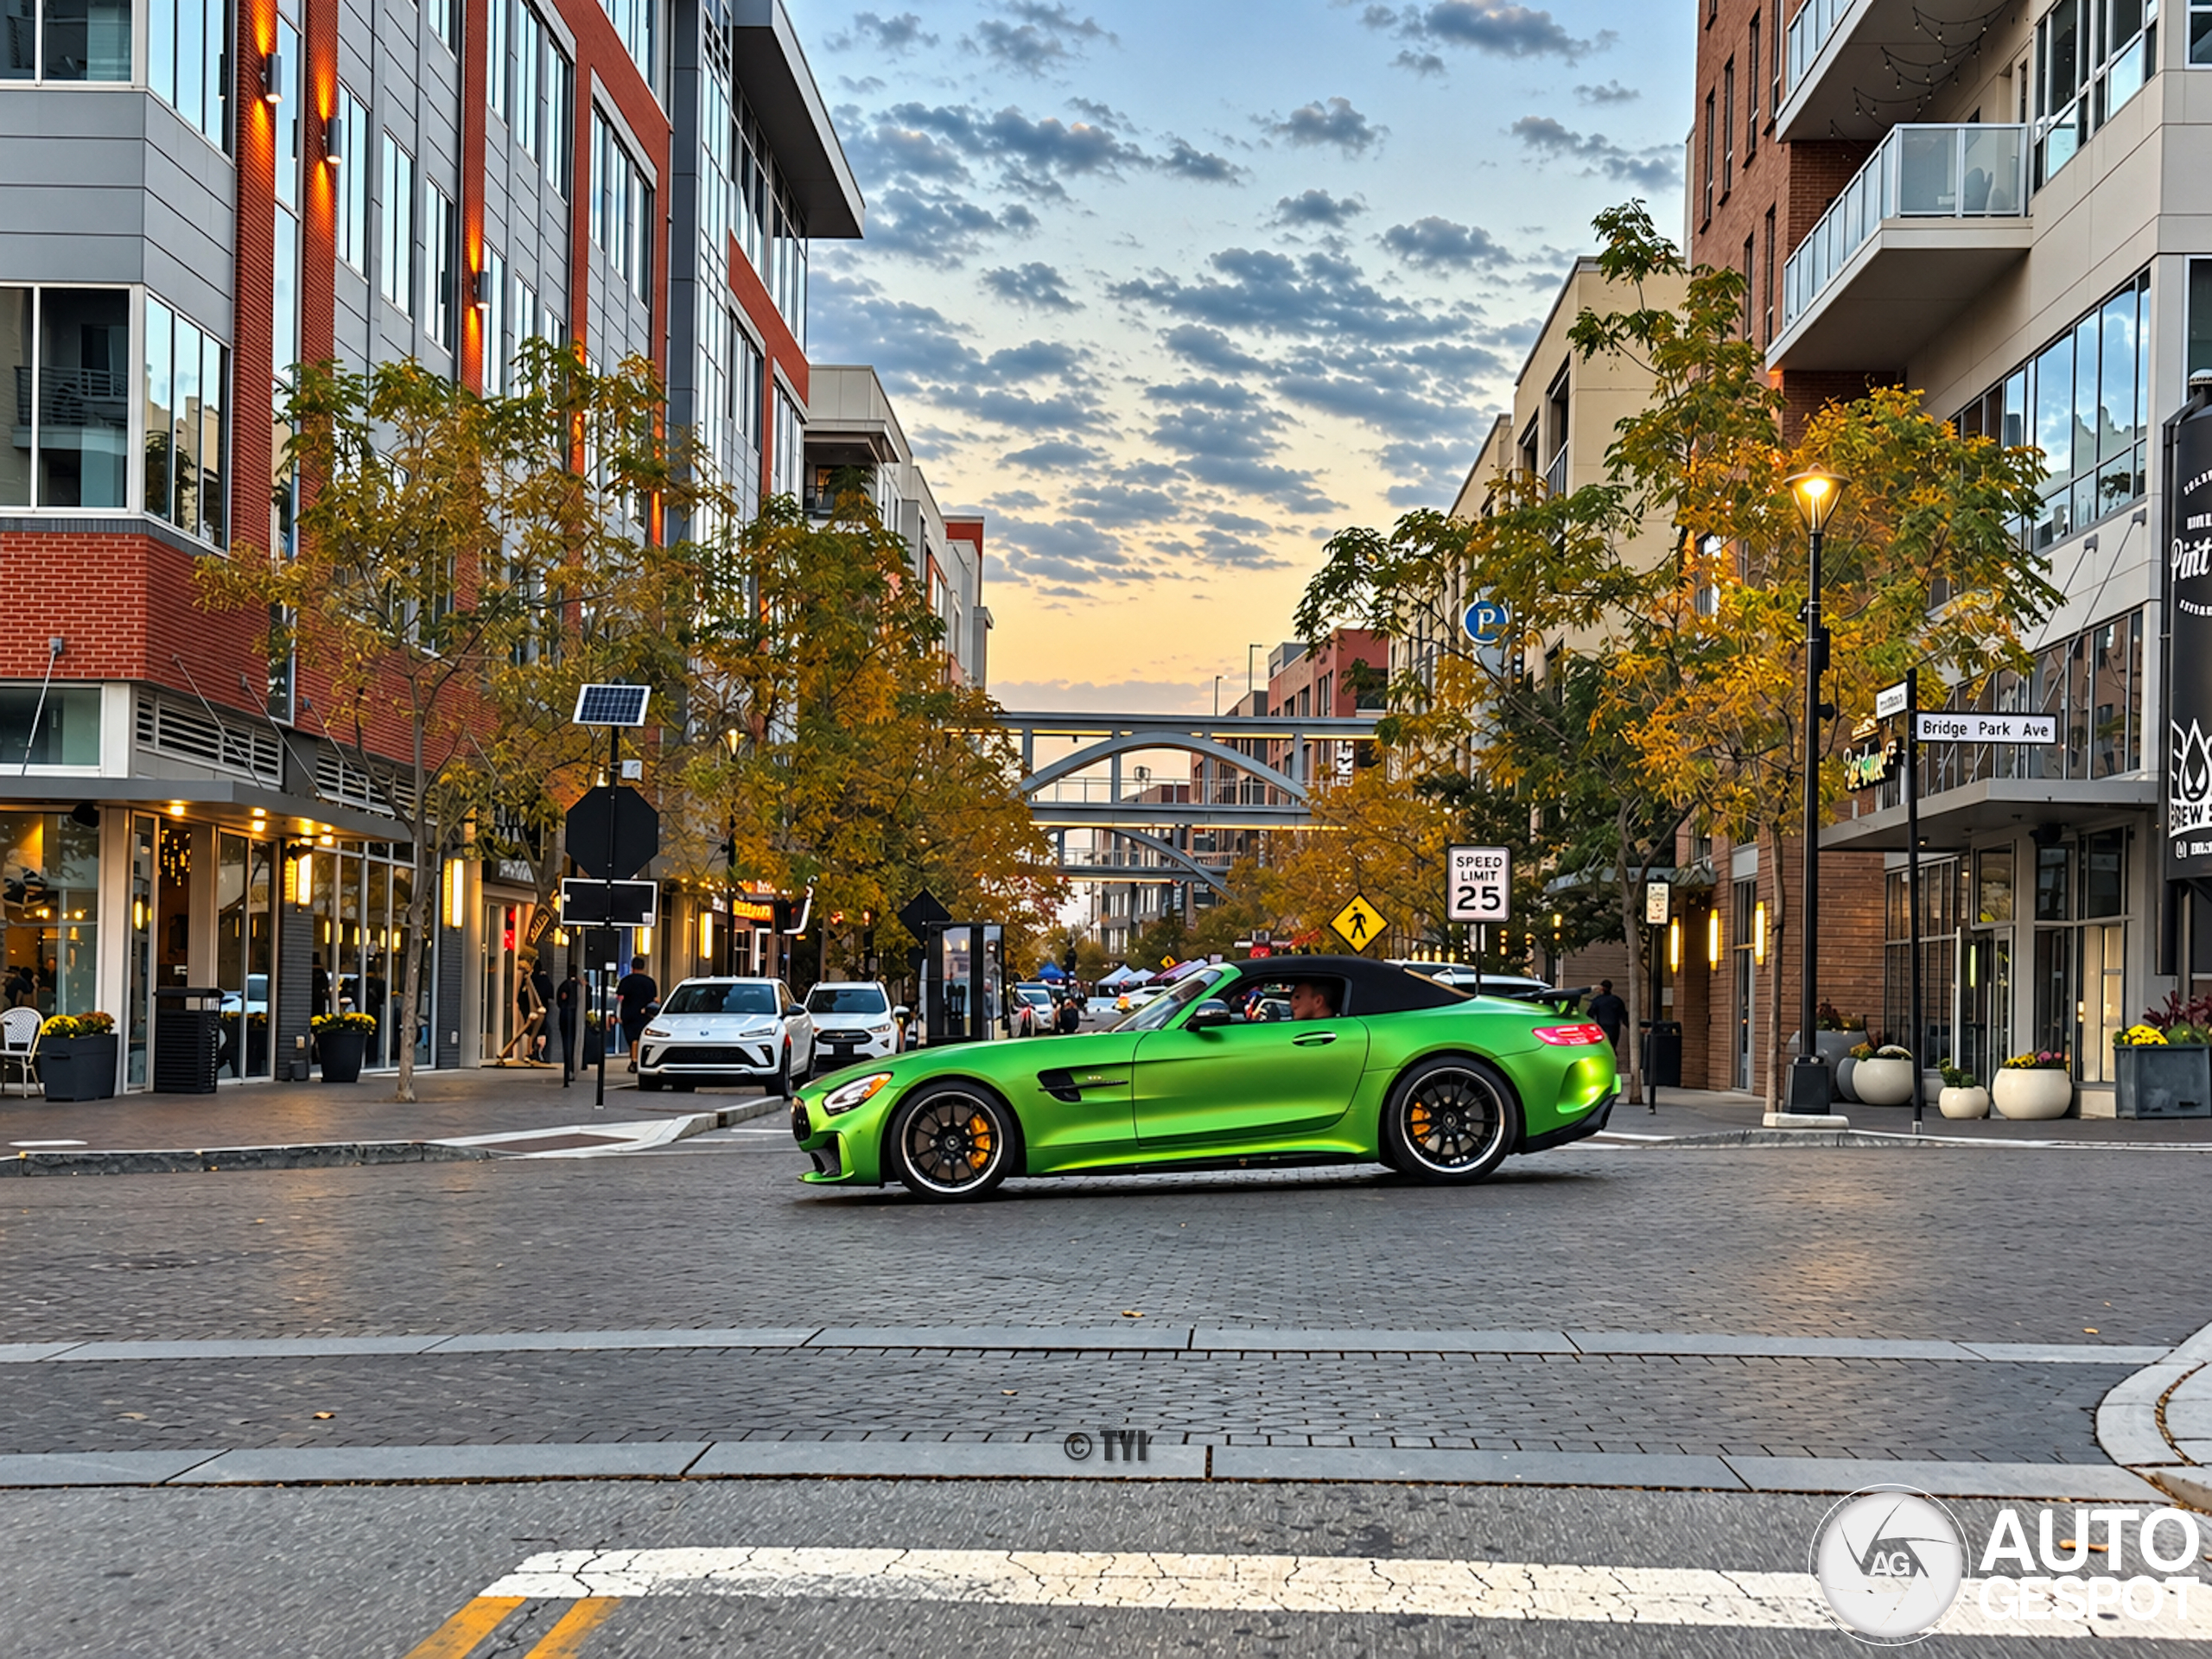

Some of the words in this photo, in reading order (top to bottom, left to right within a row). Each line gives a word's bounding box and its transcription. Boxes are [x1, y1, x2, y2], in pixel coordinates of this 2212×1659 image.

[1478, 608, 1496, 634] P
[1923, 720, 1967, 738] Bridge
[1980, 721, 2010, 735] Park
[2023, 722, 2049, 736] Ave
[1456, 855, 1503, 868] SPEED
[1461, 870, 1497, 881] LIMIT
[1457, 886, 1501, 911] 25
